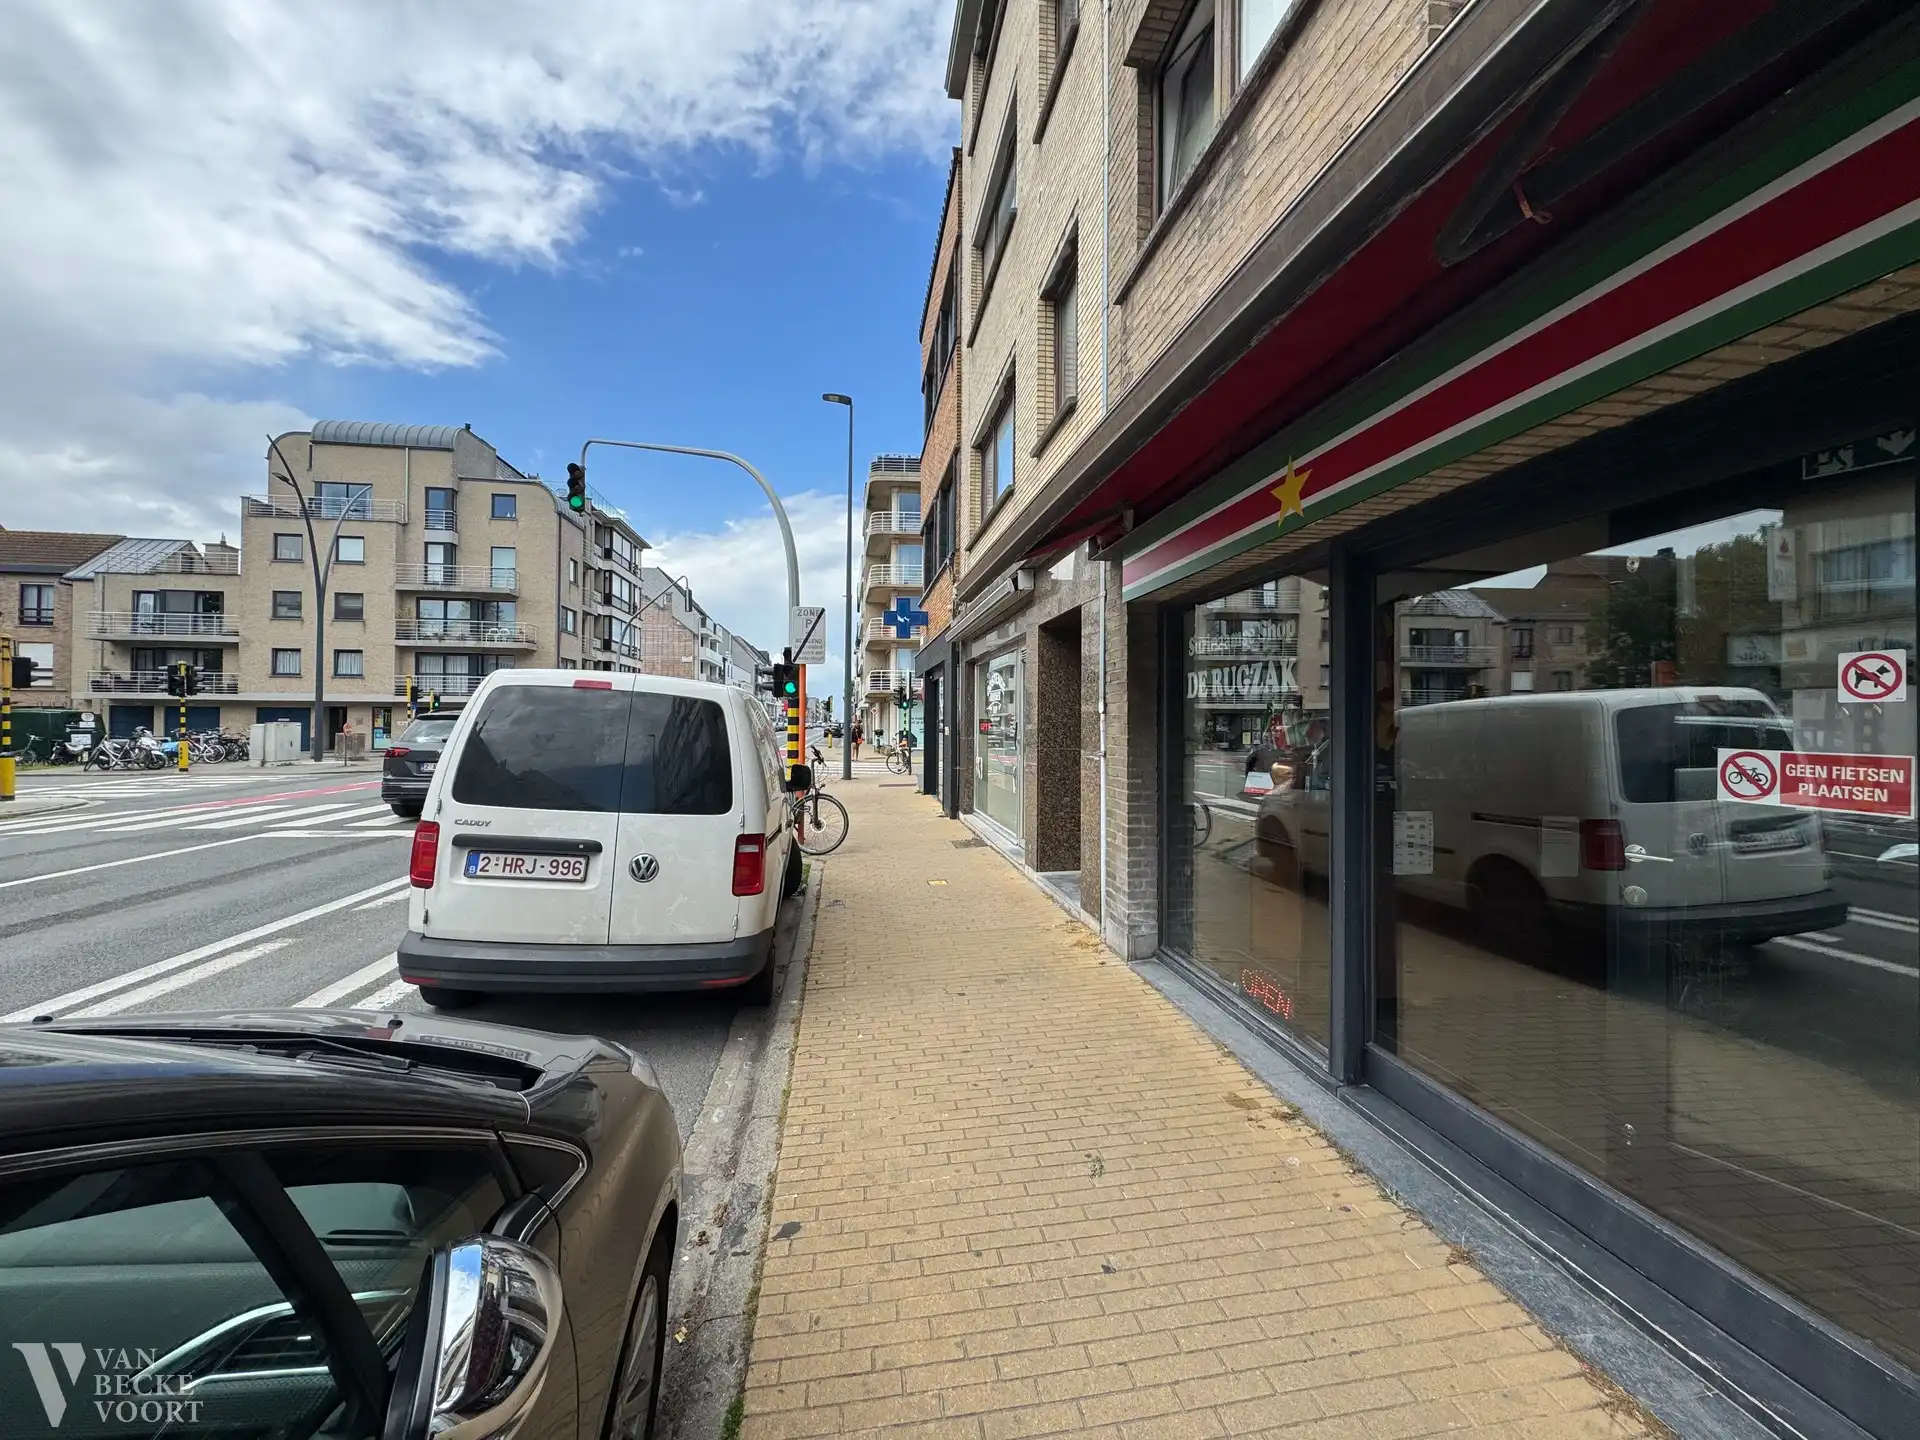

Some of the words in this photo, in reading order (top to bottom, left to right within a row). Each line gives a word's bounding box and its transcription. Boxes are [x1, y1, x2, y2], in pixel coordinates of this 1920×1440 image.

[1259, 618, 1296, 644] Shop
[1187, 670, 1208, 699] DE
[1211, 657, 1299, 698] RUGZAK
[1785, 763, 1828, 779] GEEN
[1832, 766, 1905, 784] FIETSEN
[1798, 782, 1888, 803] PLAATSEN
[454, 818, 493, 828] CADDY
[479, 855, 583, 877] 2-HRJ-996
[1241, 968, 1290, 1020] OPEN
